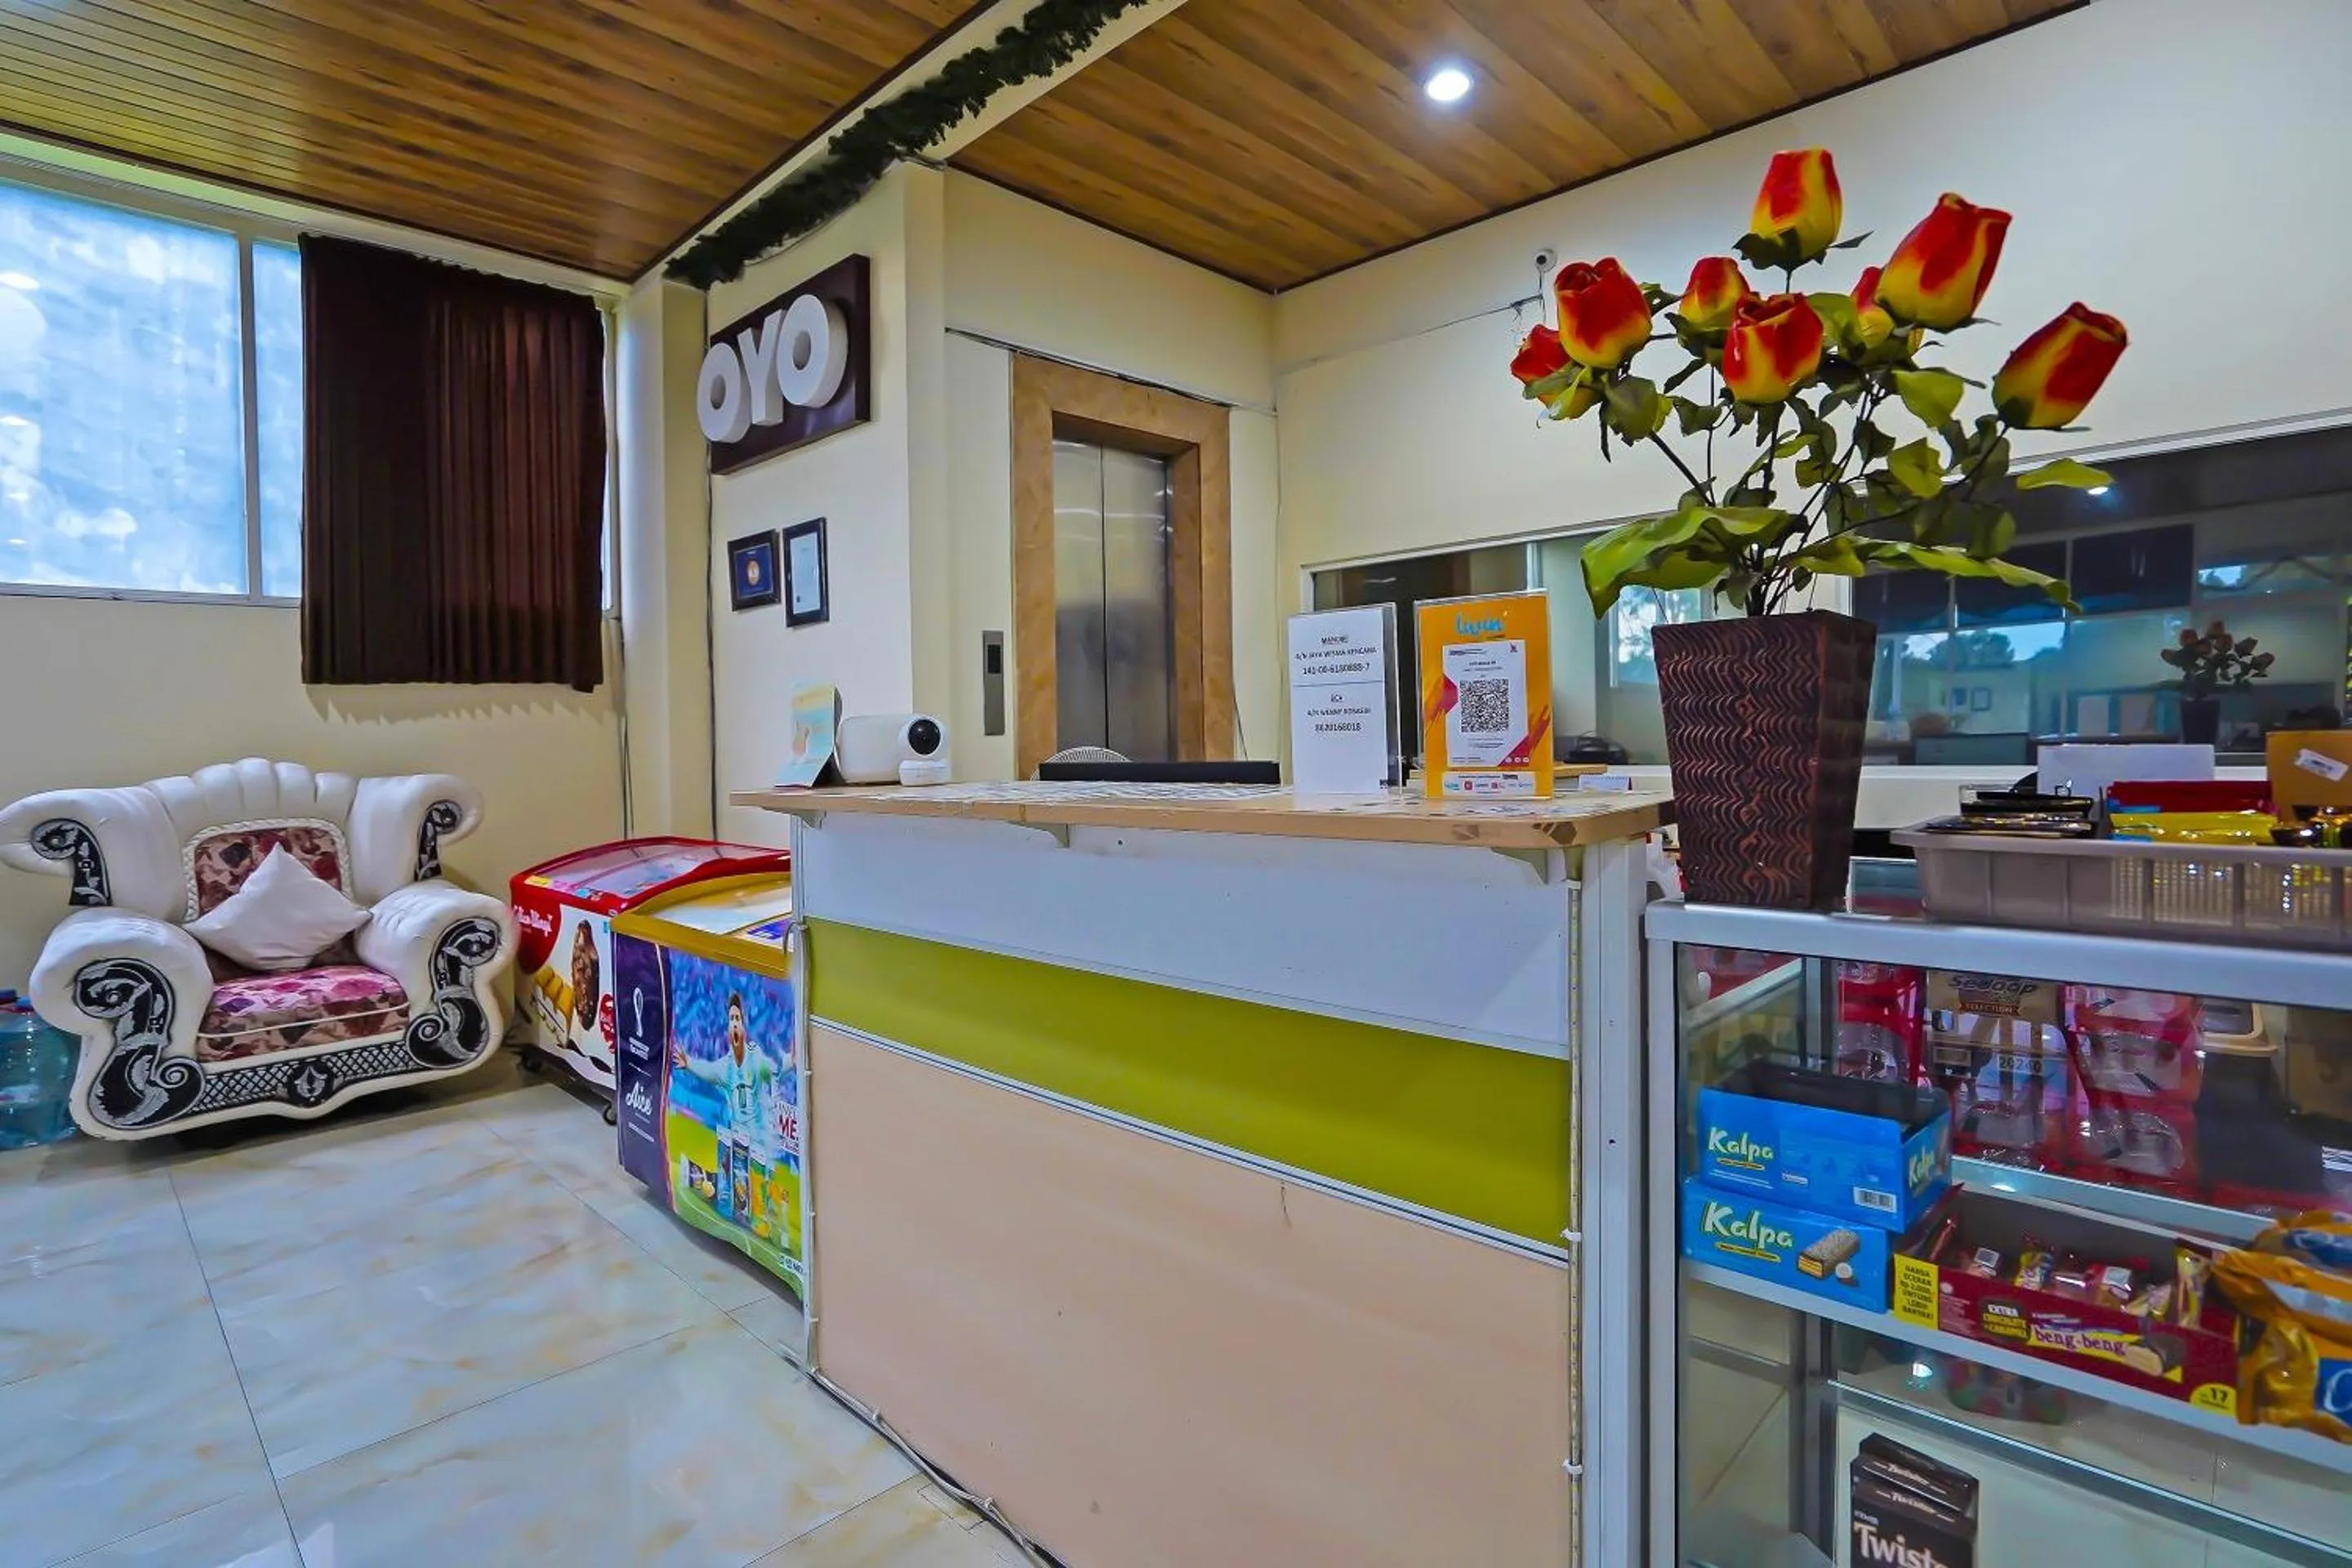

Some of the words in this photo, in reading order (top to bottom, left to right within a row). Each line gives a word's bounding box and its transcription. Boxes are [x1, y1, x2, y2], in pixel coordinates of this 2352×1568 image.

[697, 294, 845, 443] OYO
[1708, 1126, 1774, 1160] Kalpa
[1703, 1200, 1794, 1250] Kalpa
